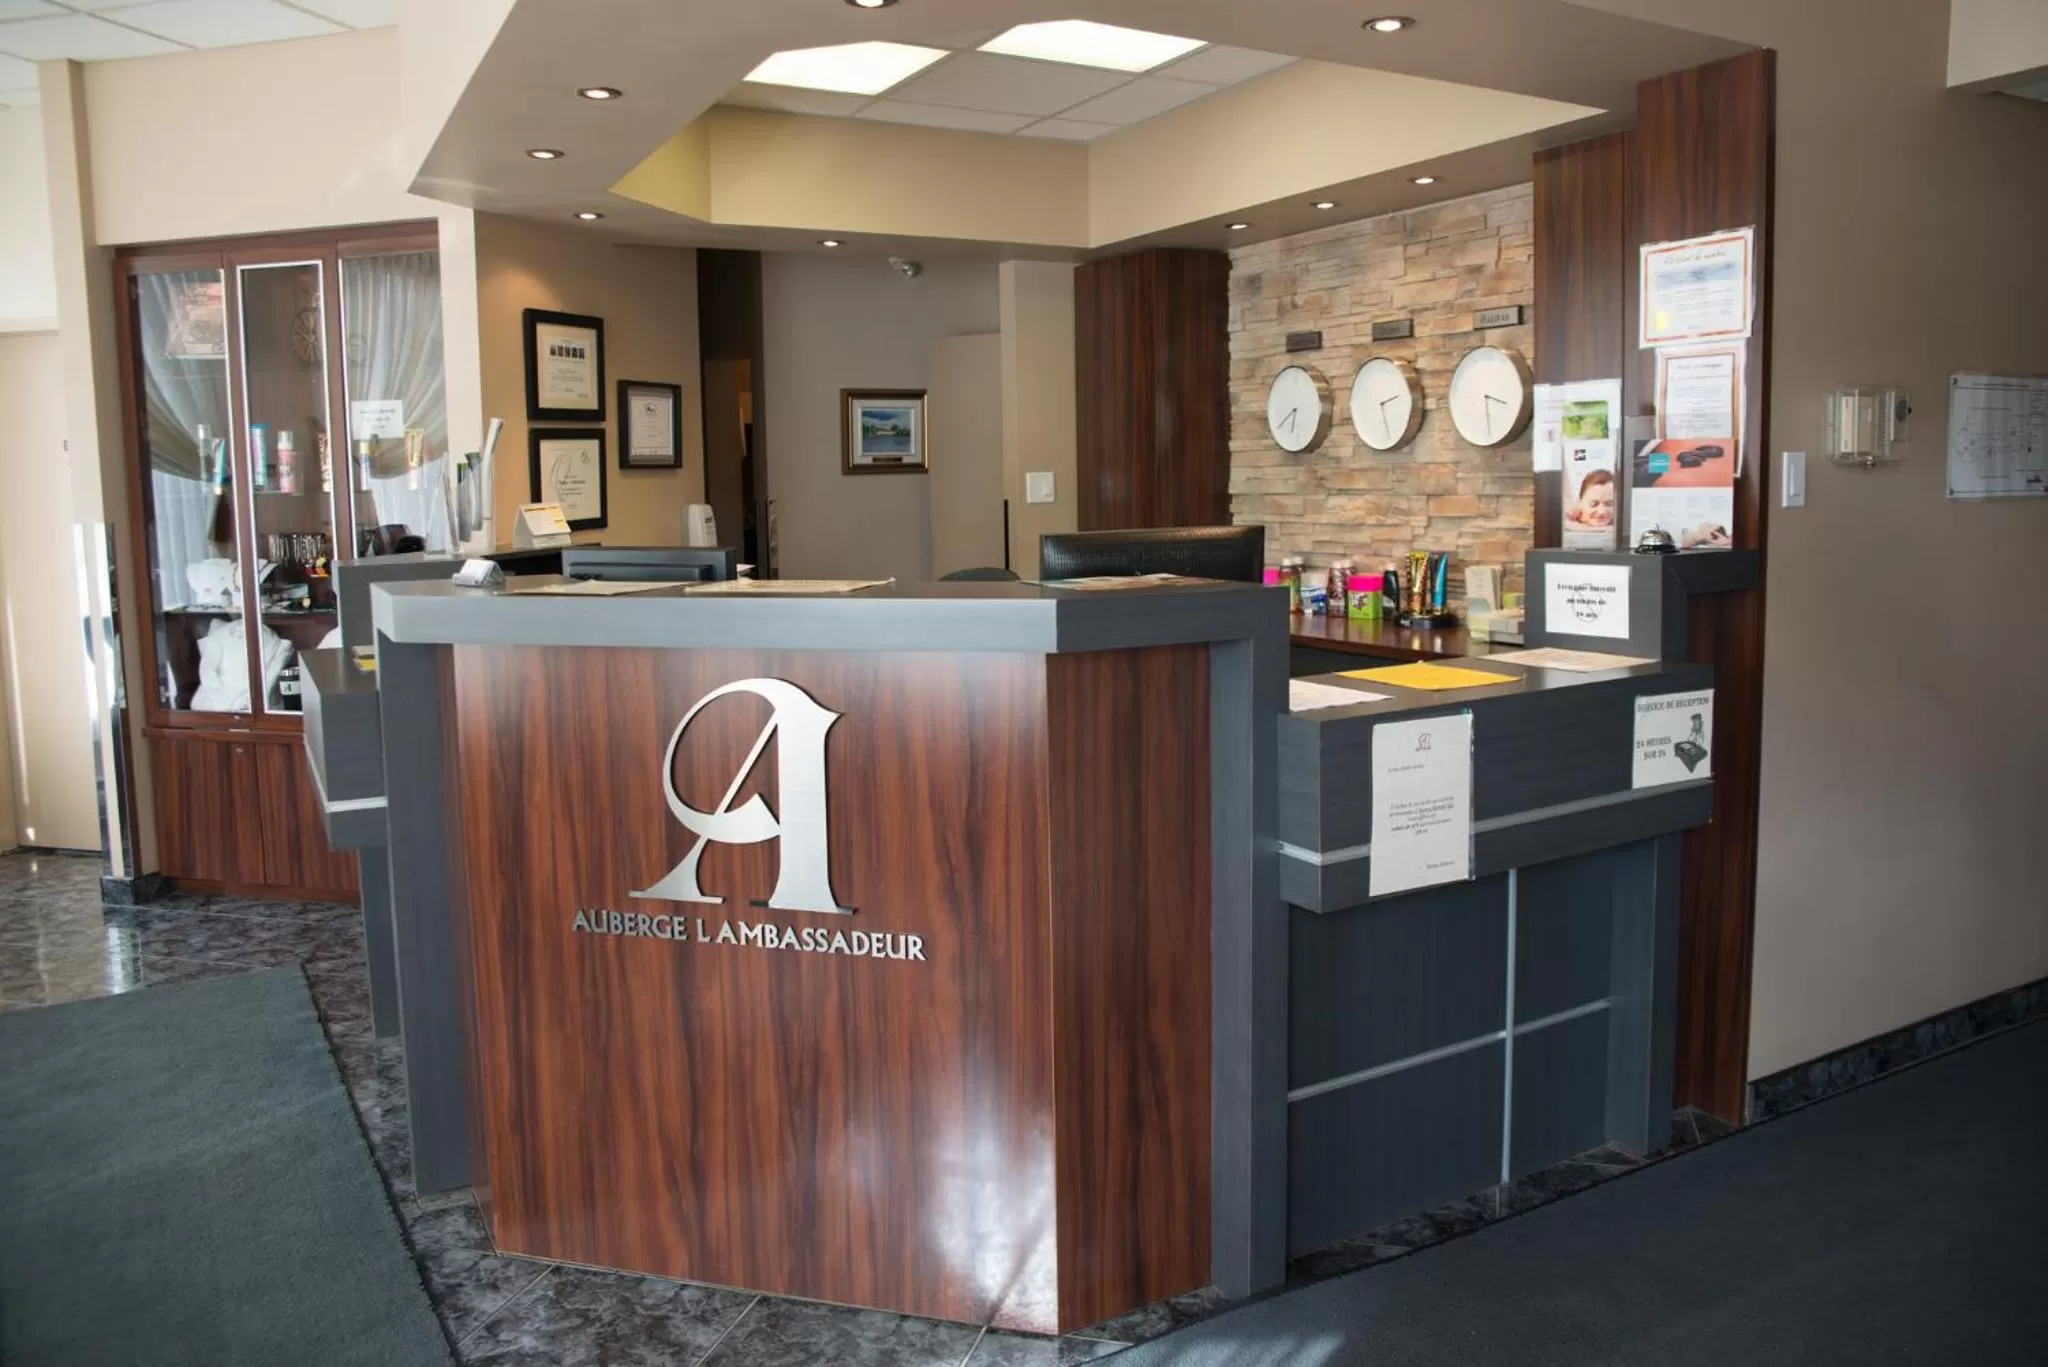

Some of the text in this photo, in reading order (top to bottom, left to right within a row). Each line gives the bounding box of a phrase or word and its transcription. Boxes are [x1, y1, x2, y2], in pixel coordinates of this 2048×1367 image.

[571, 909, 926, 961] AUBERGE L AMBASSADEUR
